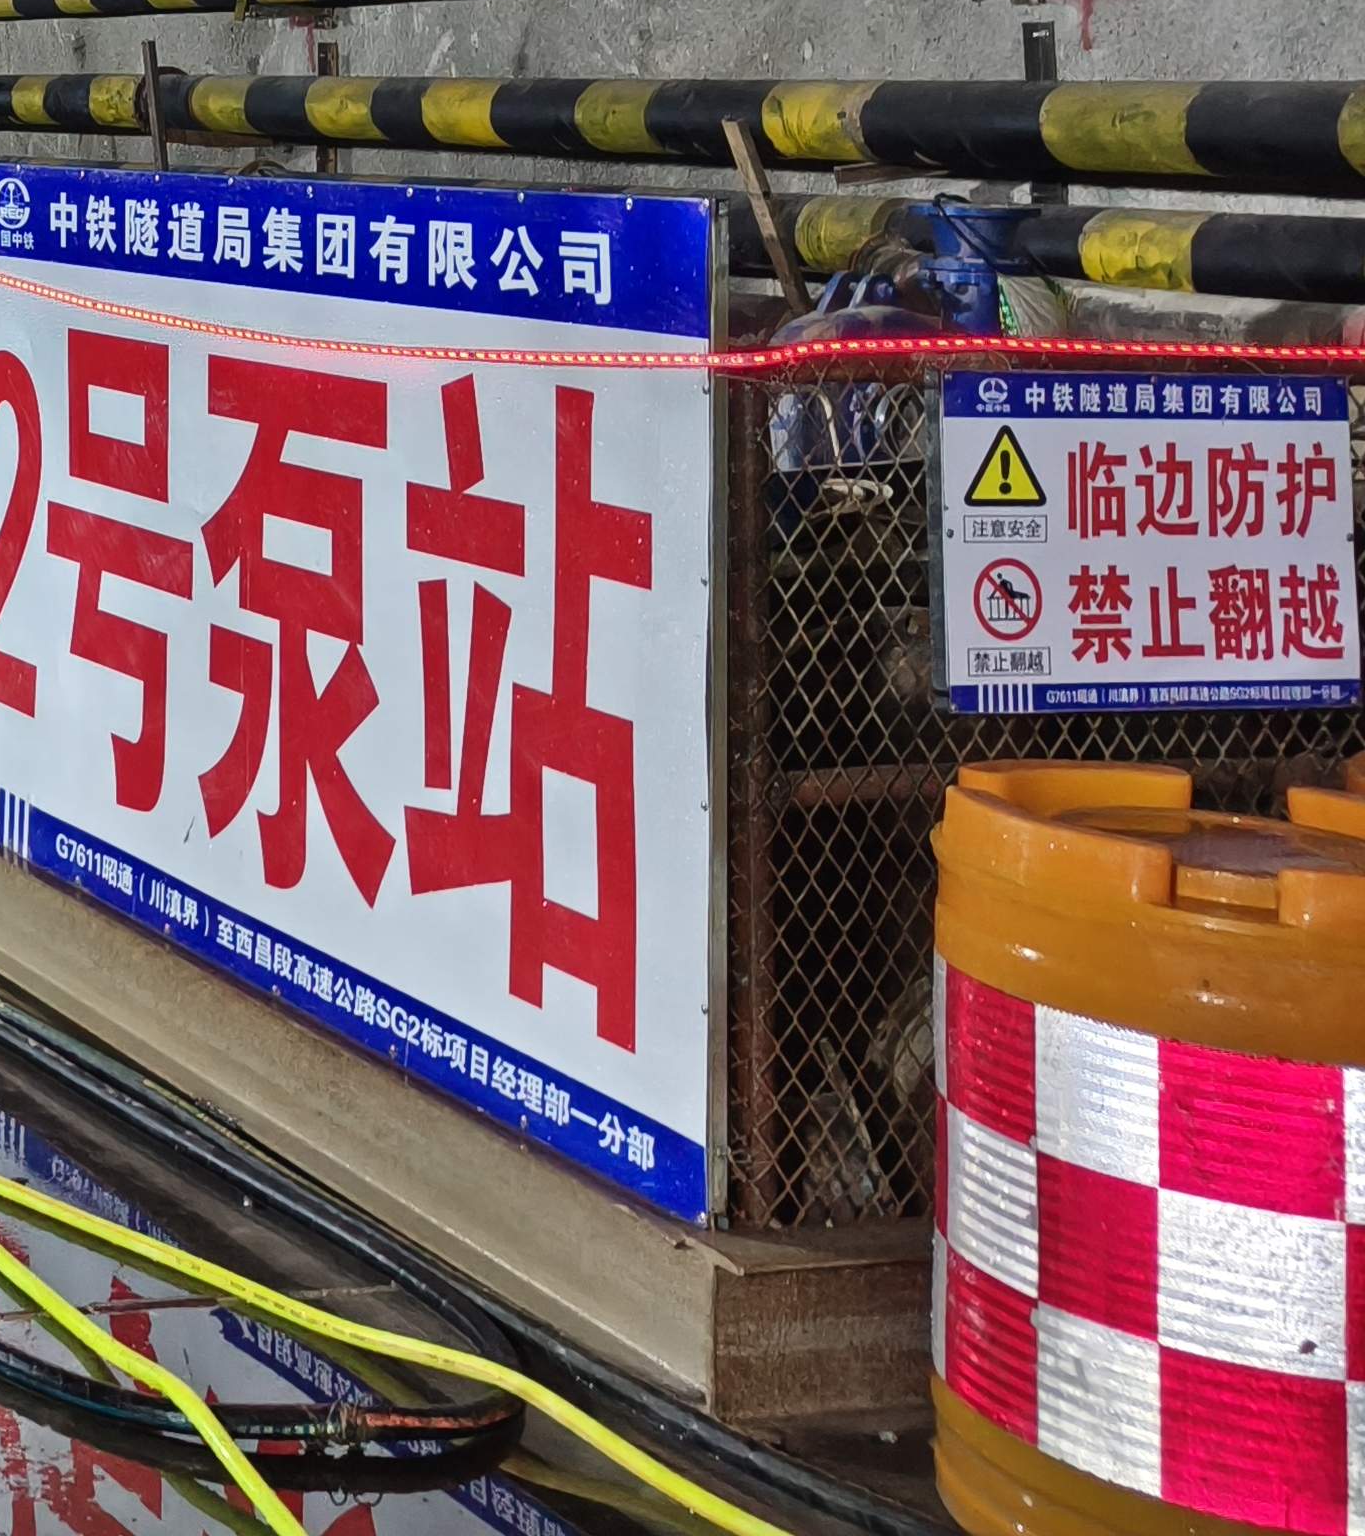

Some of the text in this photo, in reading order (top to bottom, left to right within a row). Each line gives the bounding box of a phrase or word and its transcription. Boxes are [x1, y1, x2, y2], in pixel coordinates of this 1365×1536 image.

[49, 191, 612, 305] 中铁隧道局集团有限公司
[1025, 382, 1323, 415] 中铁隧道局集团有限公司
[972, 519, 1042, 538] 注意安全
[1067, 441, 1337, 540] 临边防护
[1067, 564, 1344, 663] 禁止翻越
